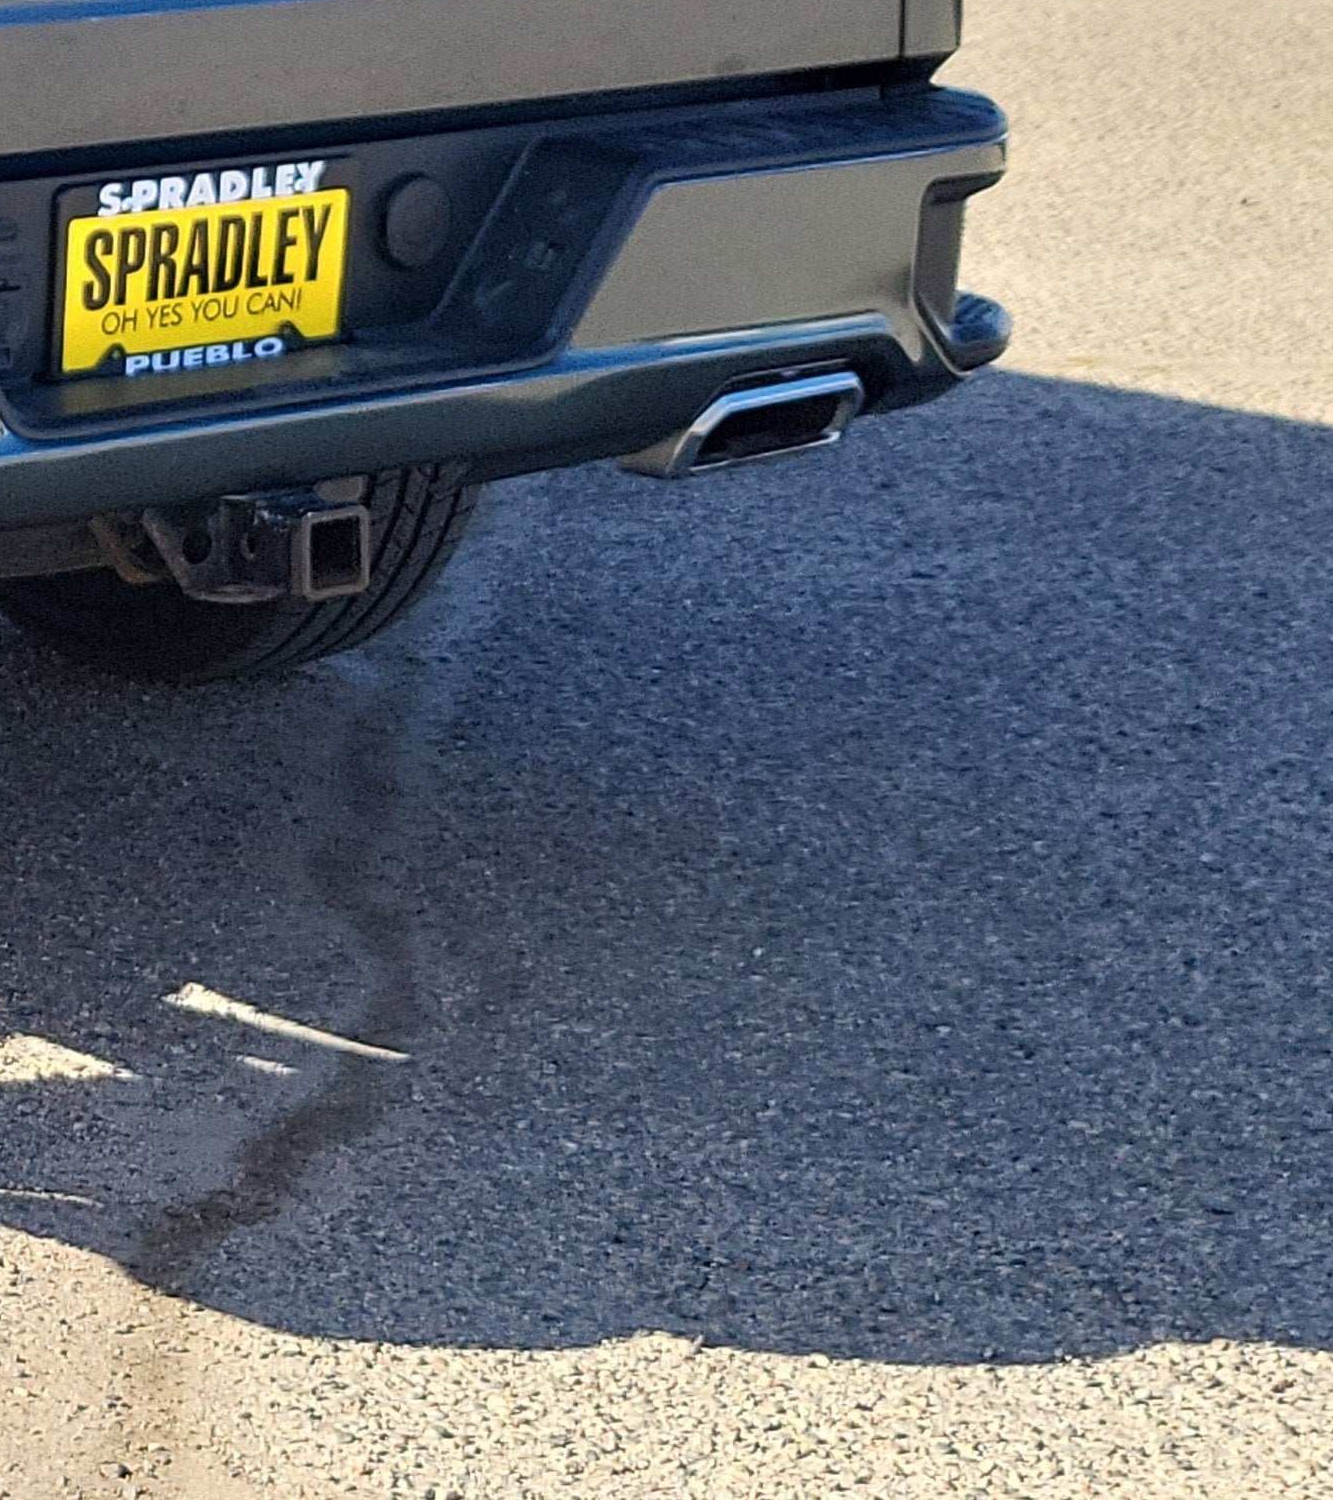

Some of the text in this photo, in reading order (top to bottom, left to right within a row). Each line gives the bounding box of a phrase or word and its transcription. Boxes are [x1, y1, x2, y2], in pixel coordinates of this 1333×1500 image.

[98, 160, 326, 216] SPRADLEY
[82, 203, 333, 311] SPRADLEY
[101, 287, 302, 336] OH YES YOU CAN!
[124, 336, 284, 377] PUEBLO
